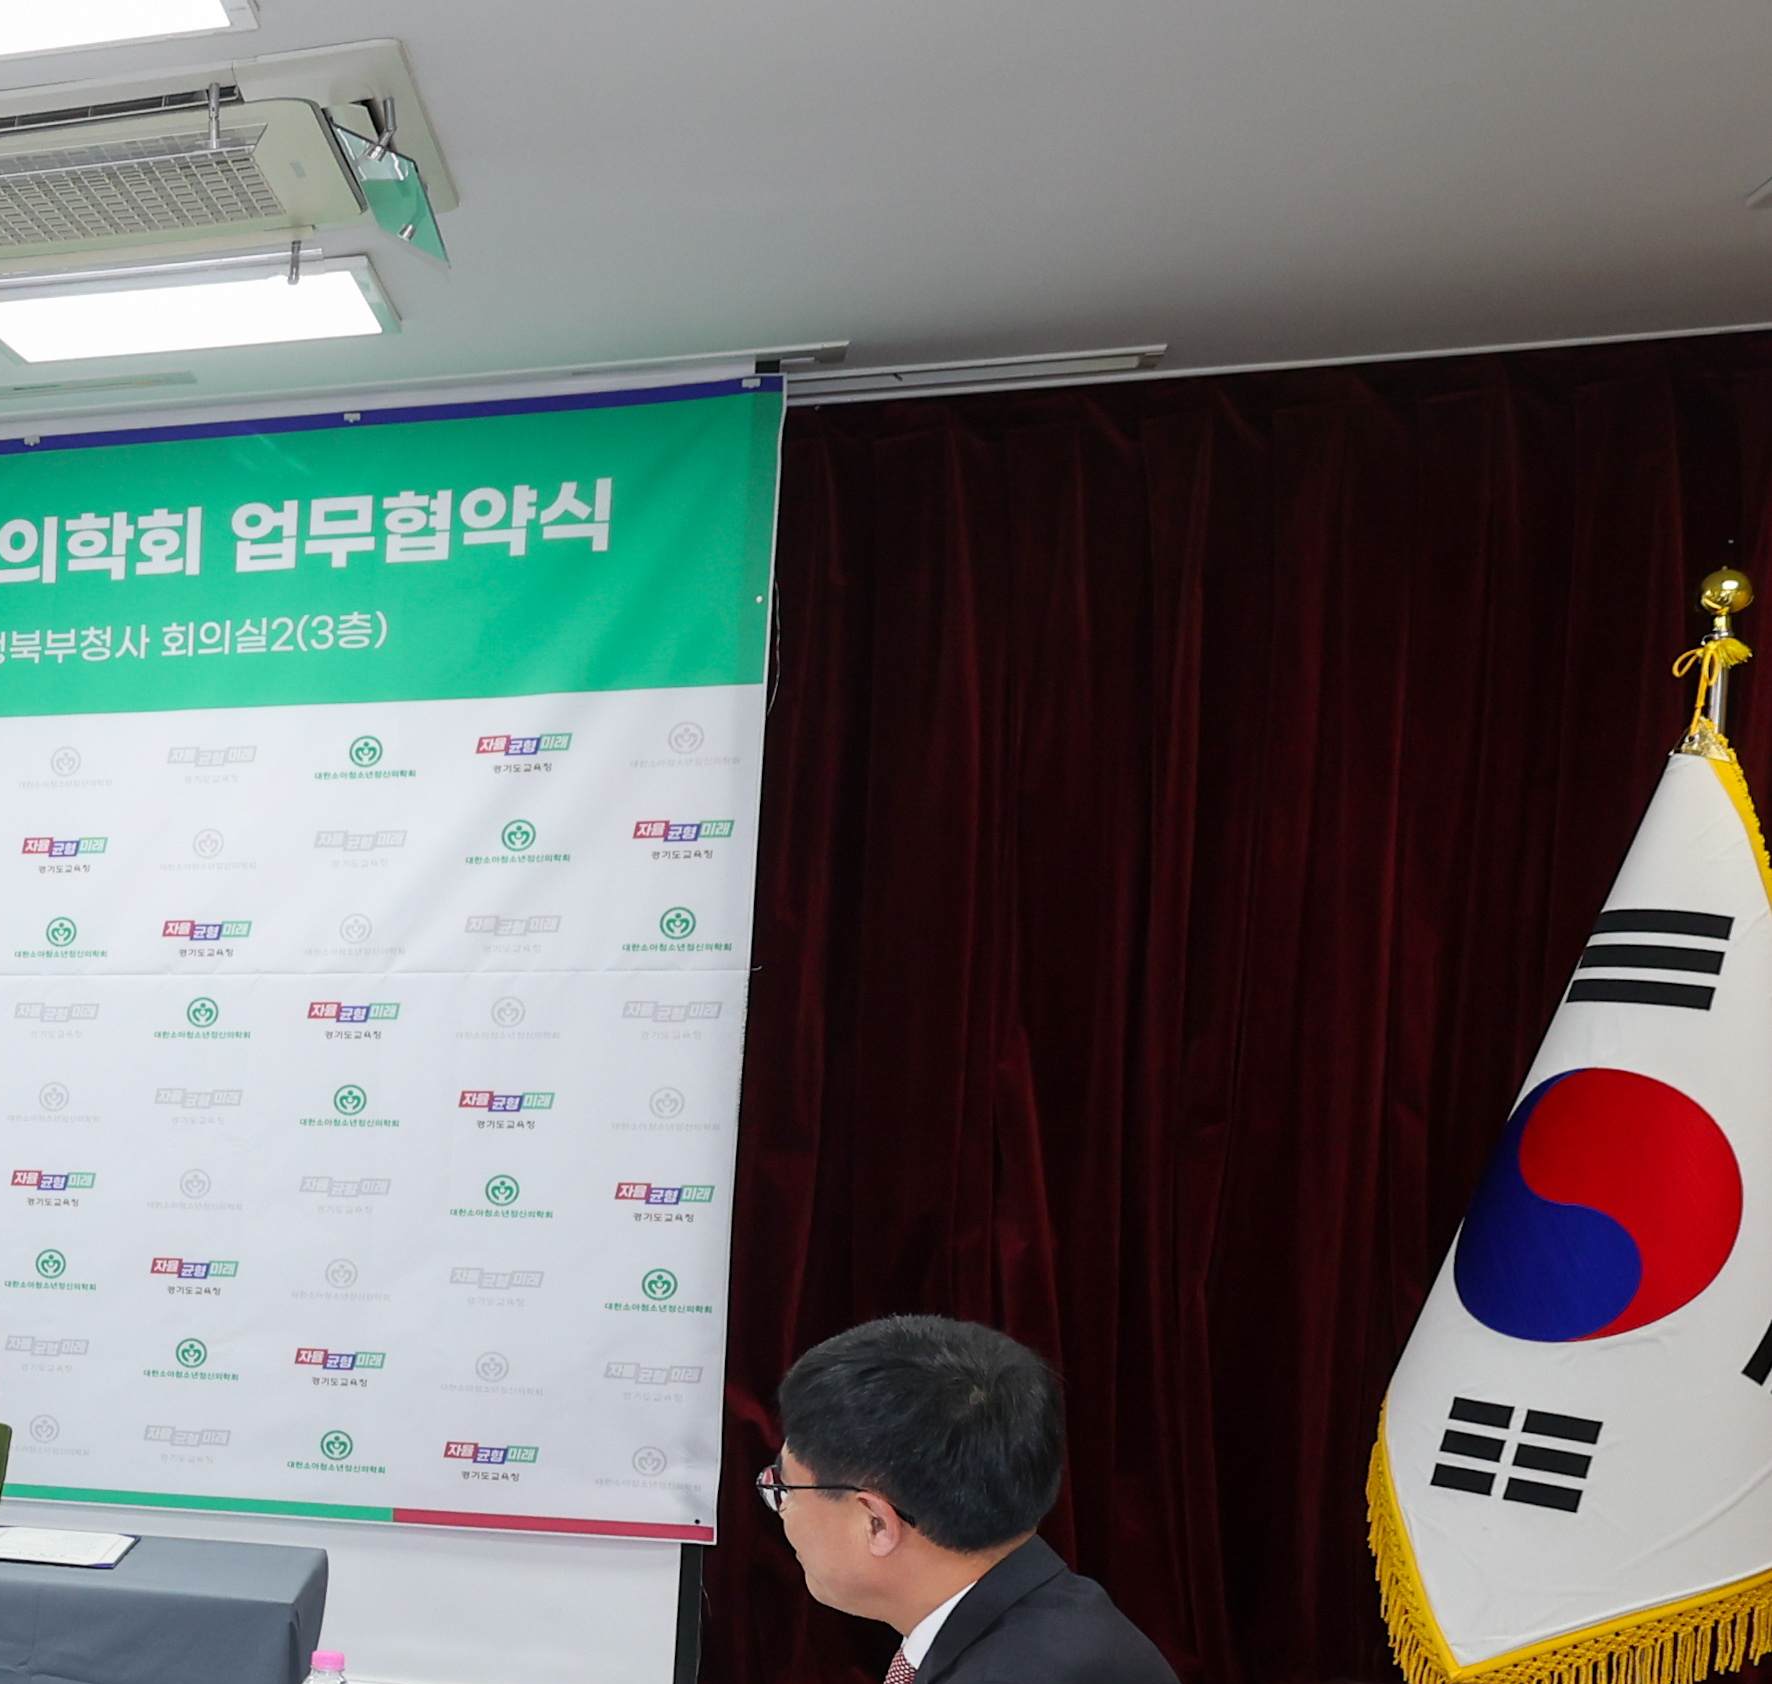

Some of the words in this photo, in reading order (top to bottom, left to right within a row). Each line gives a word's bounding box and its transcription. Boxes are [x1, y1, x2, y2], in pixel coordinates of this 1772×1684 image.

[231, 478, 613, 574] 업무협약식
[160, 611, 390, 660] 회의실2(3층)
[478, 736, 508, 753] 자율
[507, 738, 538, 755] 균형
[540, 734, 571, 750] 미래
[493, 762, 553, 773] 경기도교육청
[636, 821, 667, 838] 자율
[666, 824, 699, 841] 균형
[700, 821, 731, 837] 미래
[25, 839, 51, 853] 자율
[51, 841, 78, 856] 균형
[78, 838, 106, 853] 미래
[651, 849, 714, 860] 경기도교육청
[38, 864, 91, 874] 경기도교육청
[165, 921, 192, 936] 자율
[192, 925, 220, 940] 균형
[222, 921, 250, 937] 미래
[179, 948, 234, 957] 경기도교육청
[310, 1003, 340, 1018] 자율
[339, 1006, 368, 1022] 균형
[370, 1004, 398, 1019] 미래
[325, 1030, 382, 1040] 경기도교육청
[461, 1091, 492, 1107] 자율
[490, 1096, 521, 1112] 균형
[523, 1093, 553, 1109] 미래
[476, 1120, 535, 1130] 경기도교육청
[14, 1171, 40, 1185] 자율
[39, 1175, 66, 1190] 균형
[68, 1173, 94, 1187] 미래
[27, 1197, 79, 1207] 경기도교육청
[617, 1183, 648, 1199] 자율
[647, 1188, 680, 1204] 균형
[681, 1186, 712, 1202] 미래
[633, 1212, 695, 1223] 경기도교육청
[154, 1258, 180, 1273] 자율
[180, 1263, 208, 1279] 균형
[209, 1261, 237, 1276] 미래
[167, 1285, 221, 1296] 경기도교육청
[298, 1349, 326, 1364] 자율
[325, 1354, 355, 1370] 균형
[355, 1352, 384, 1368] 미래
[311, 1376, 368, 1388] 경기도교육청
[447, 1443, 477, 1458] 자율
[475, 1448, 506, 1464] 균형
[507, 1447, 537, 1462] 미래
[461, 1470, 520, 1482] 경기도교육청
